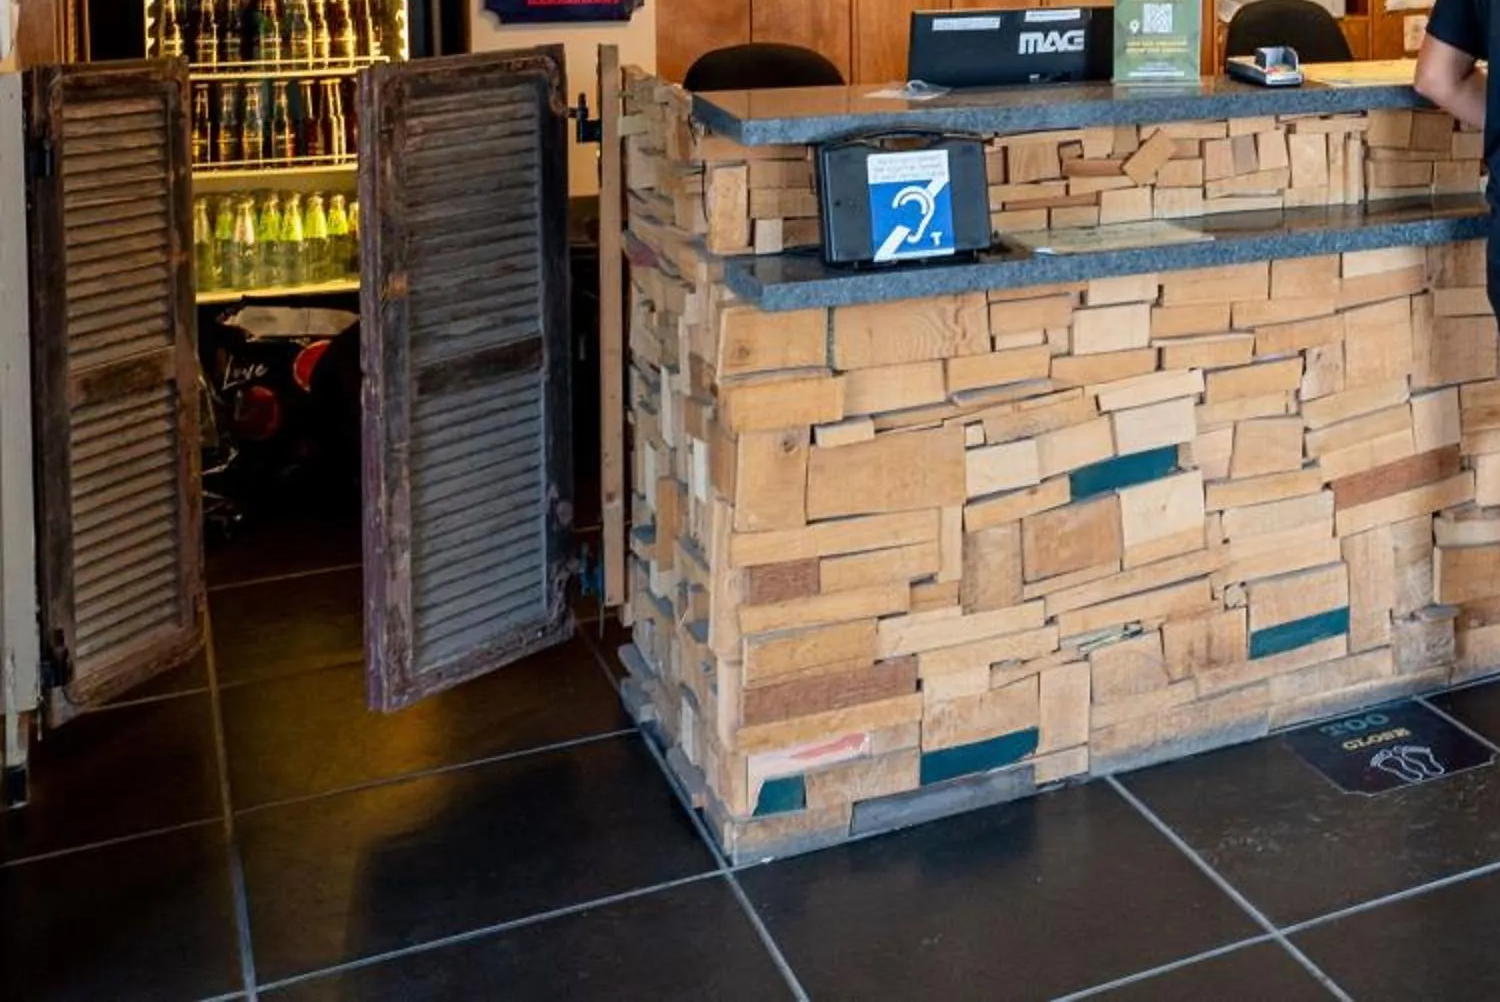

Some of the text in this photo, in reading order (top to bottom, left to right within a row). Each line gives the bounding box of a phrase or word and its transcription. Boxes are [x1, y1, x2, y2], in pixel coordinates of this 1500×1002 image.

[930, 231, 943, 246] T
[1319, 712, 1390, 738] TOO
[1342, 726, 1413, 751] CLOSE
